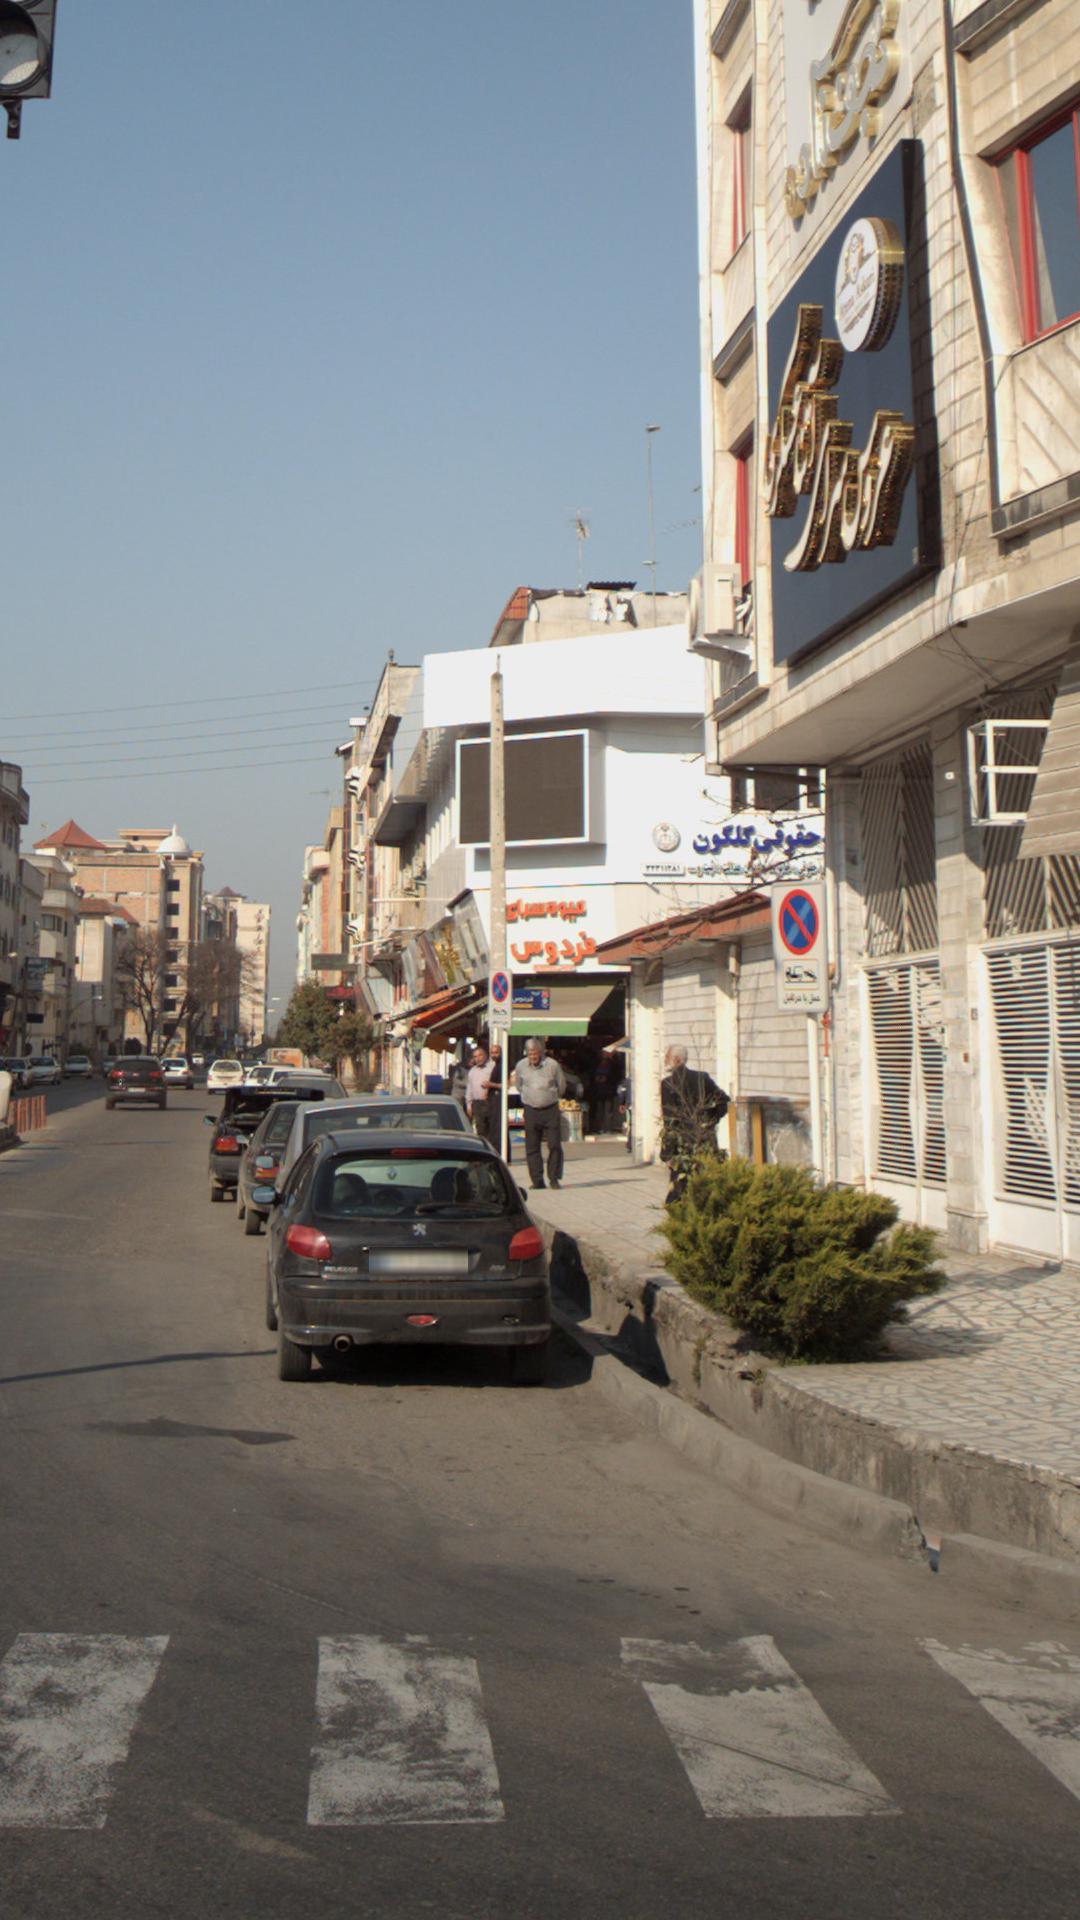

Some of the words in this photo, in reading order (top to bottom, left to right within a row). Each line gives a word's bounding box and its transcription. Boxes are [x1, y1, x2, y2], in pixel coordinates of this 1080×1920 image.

[692, 824, 756, 855] گلگون
[753, 821, 822, 856] حقوقی
[510, 930, 599, 965] فردوس
